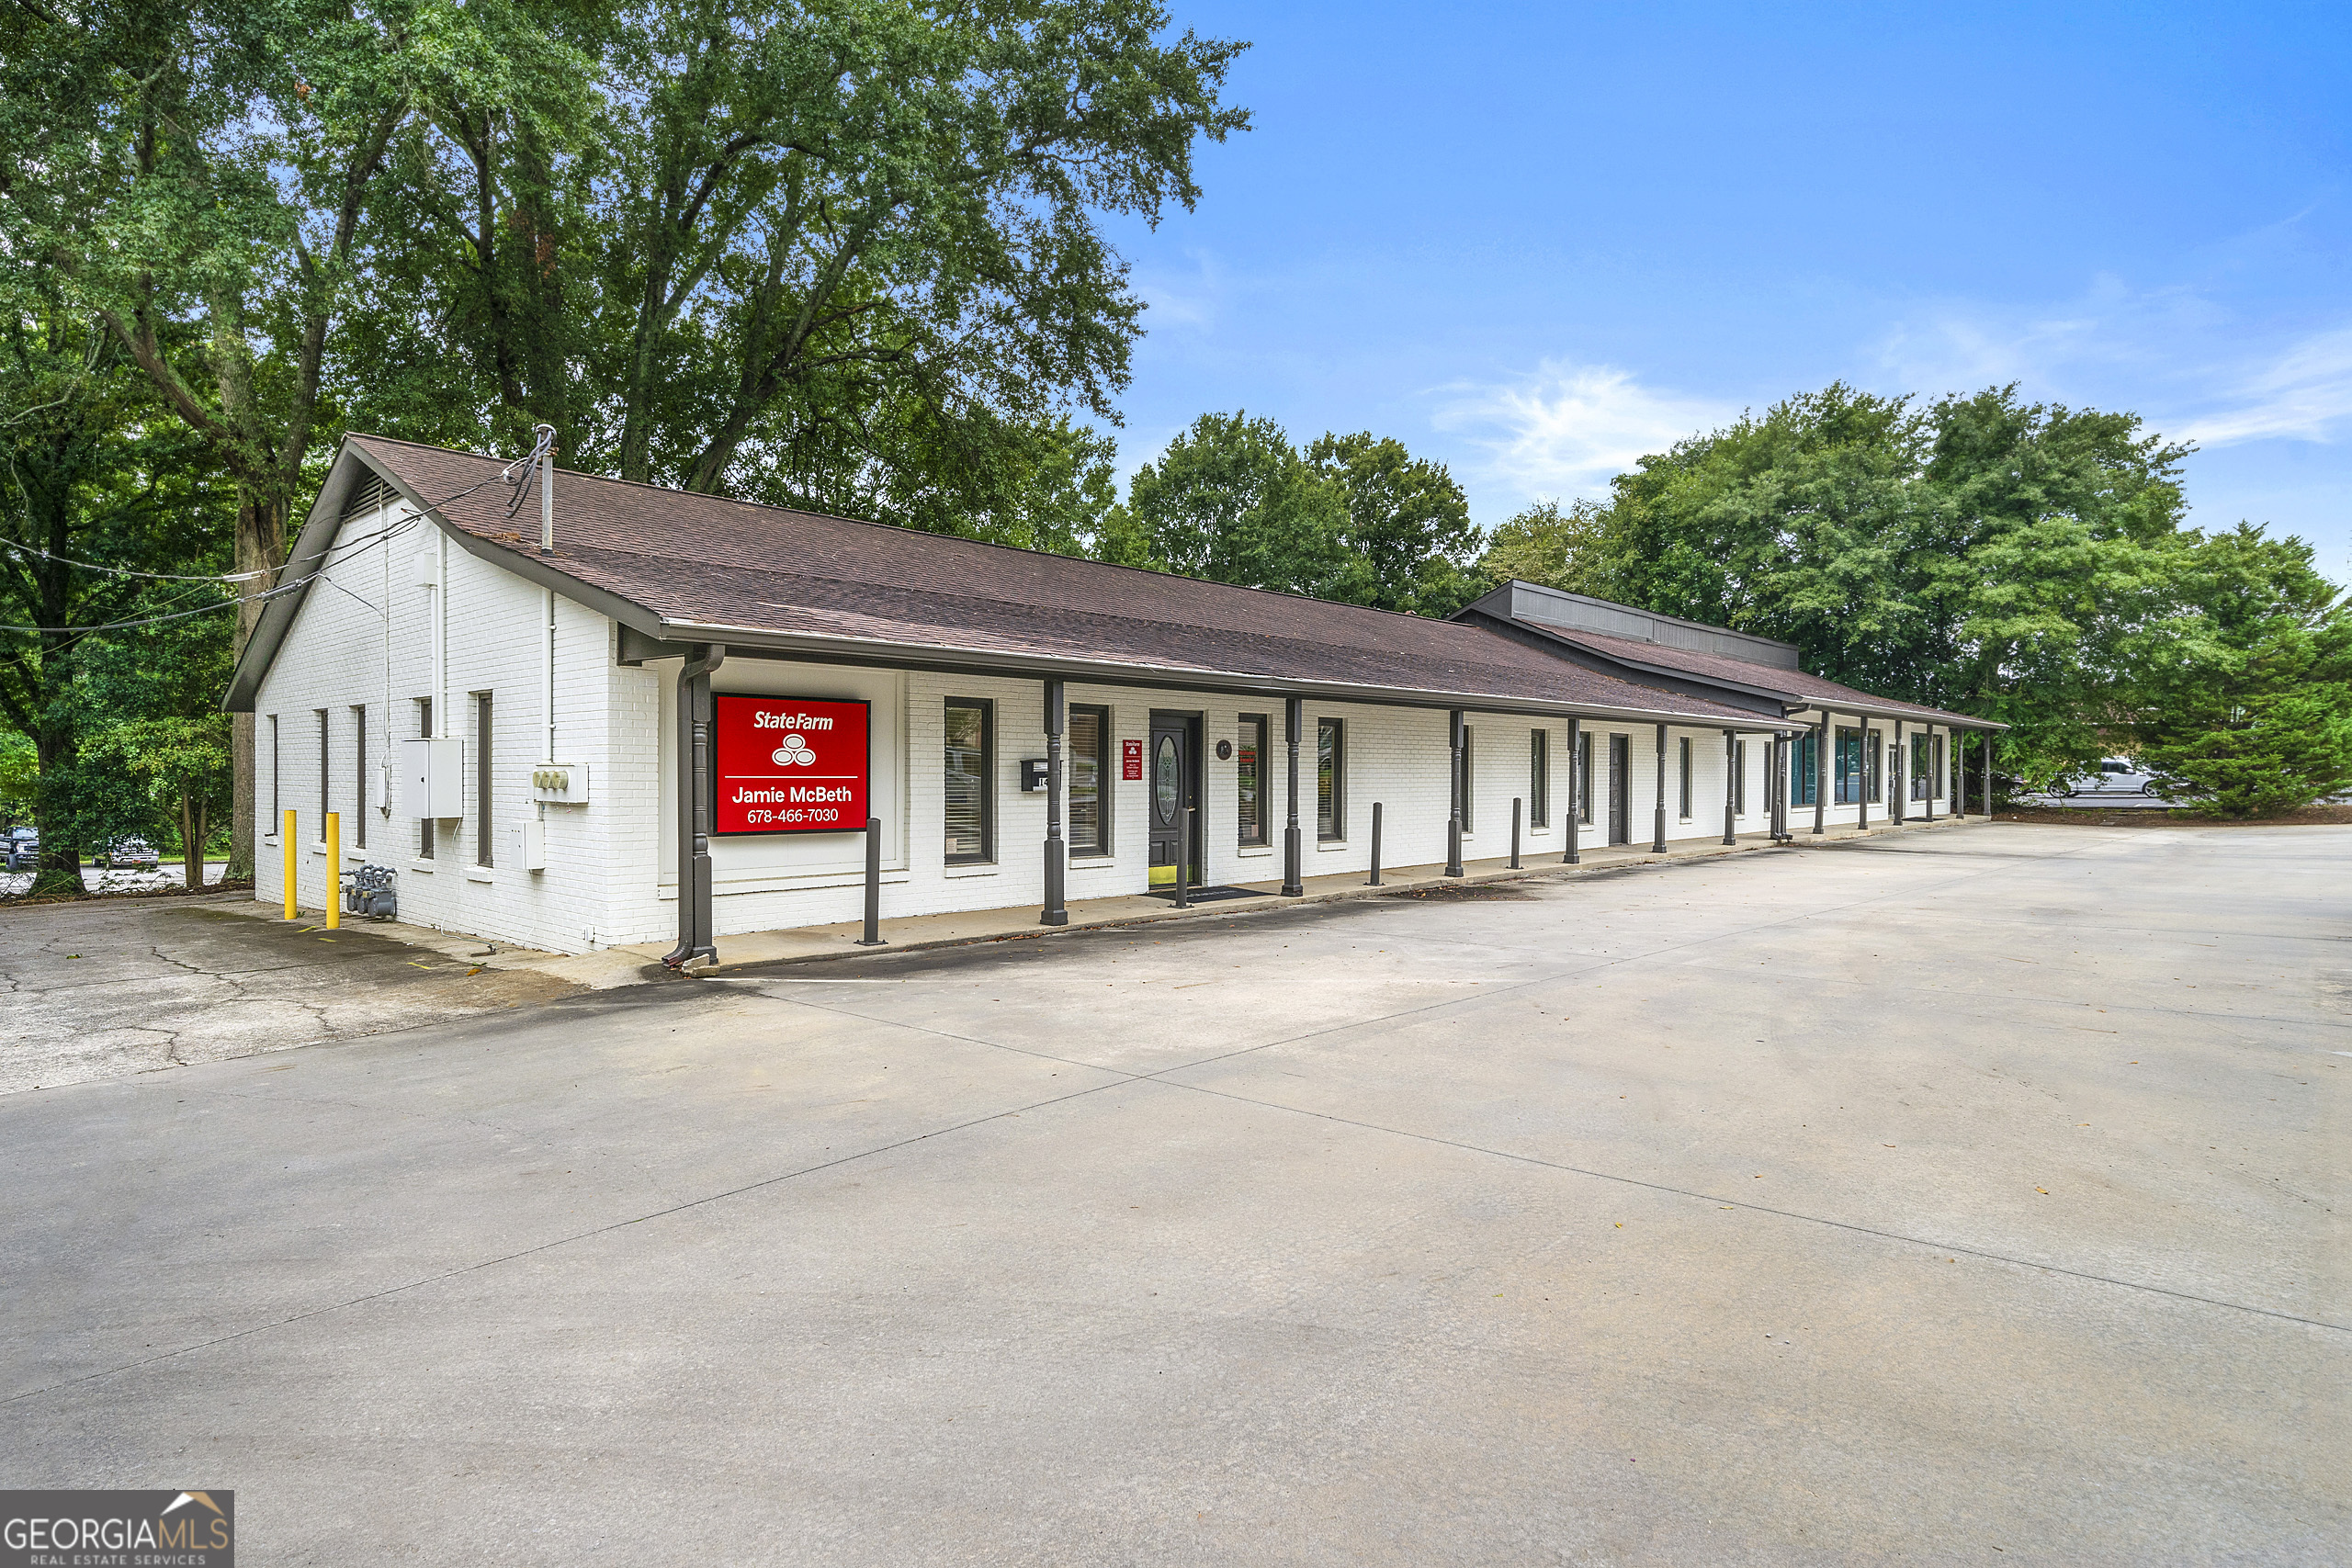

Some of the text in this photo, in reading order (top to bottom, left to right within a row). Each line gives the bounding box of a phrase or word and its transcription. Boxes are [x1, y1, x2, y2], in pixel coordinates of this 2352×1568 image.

[731, 785, 853, 804] Jamie McBeth
[747, 808, 839, 823] 678-466-7030
